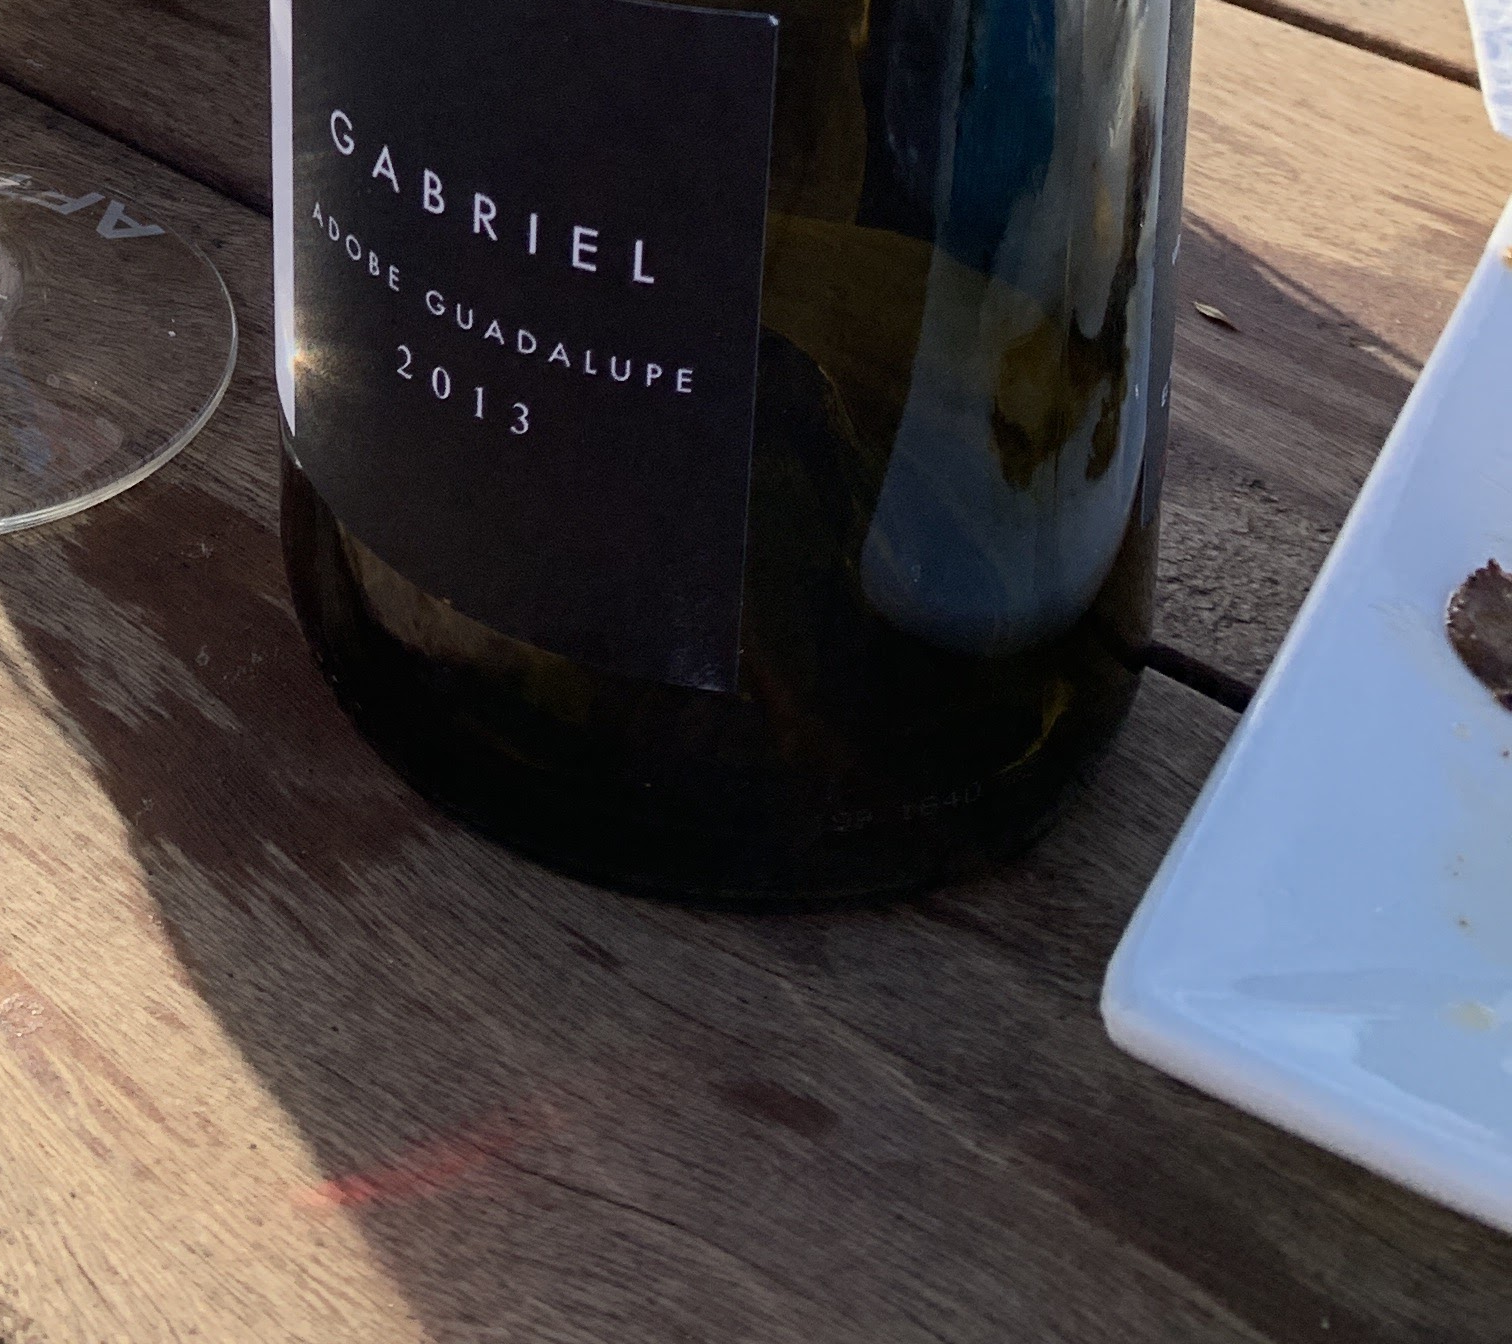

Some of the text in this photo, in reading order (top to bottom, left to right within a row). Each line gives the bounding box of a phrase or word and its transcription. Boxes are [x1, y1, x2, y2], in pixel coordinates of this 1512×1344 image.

[330, 108, 656, 284] GABRIEL
[311, 200, 694, 395] ADOBE GUADALUPE
[395, 343, 531, 436] 2013
